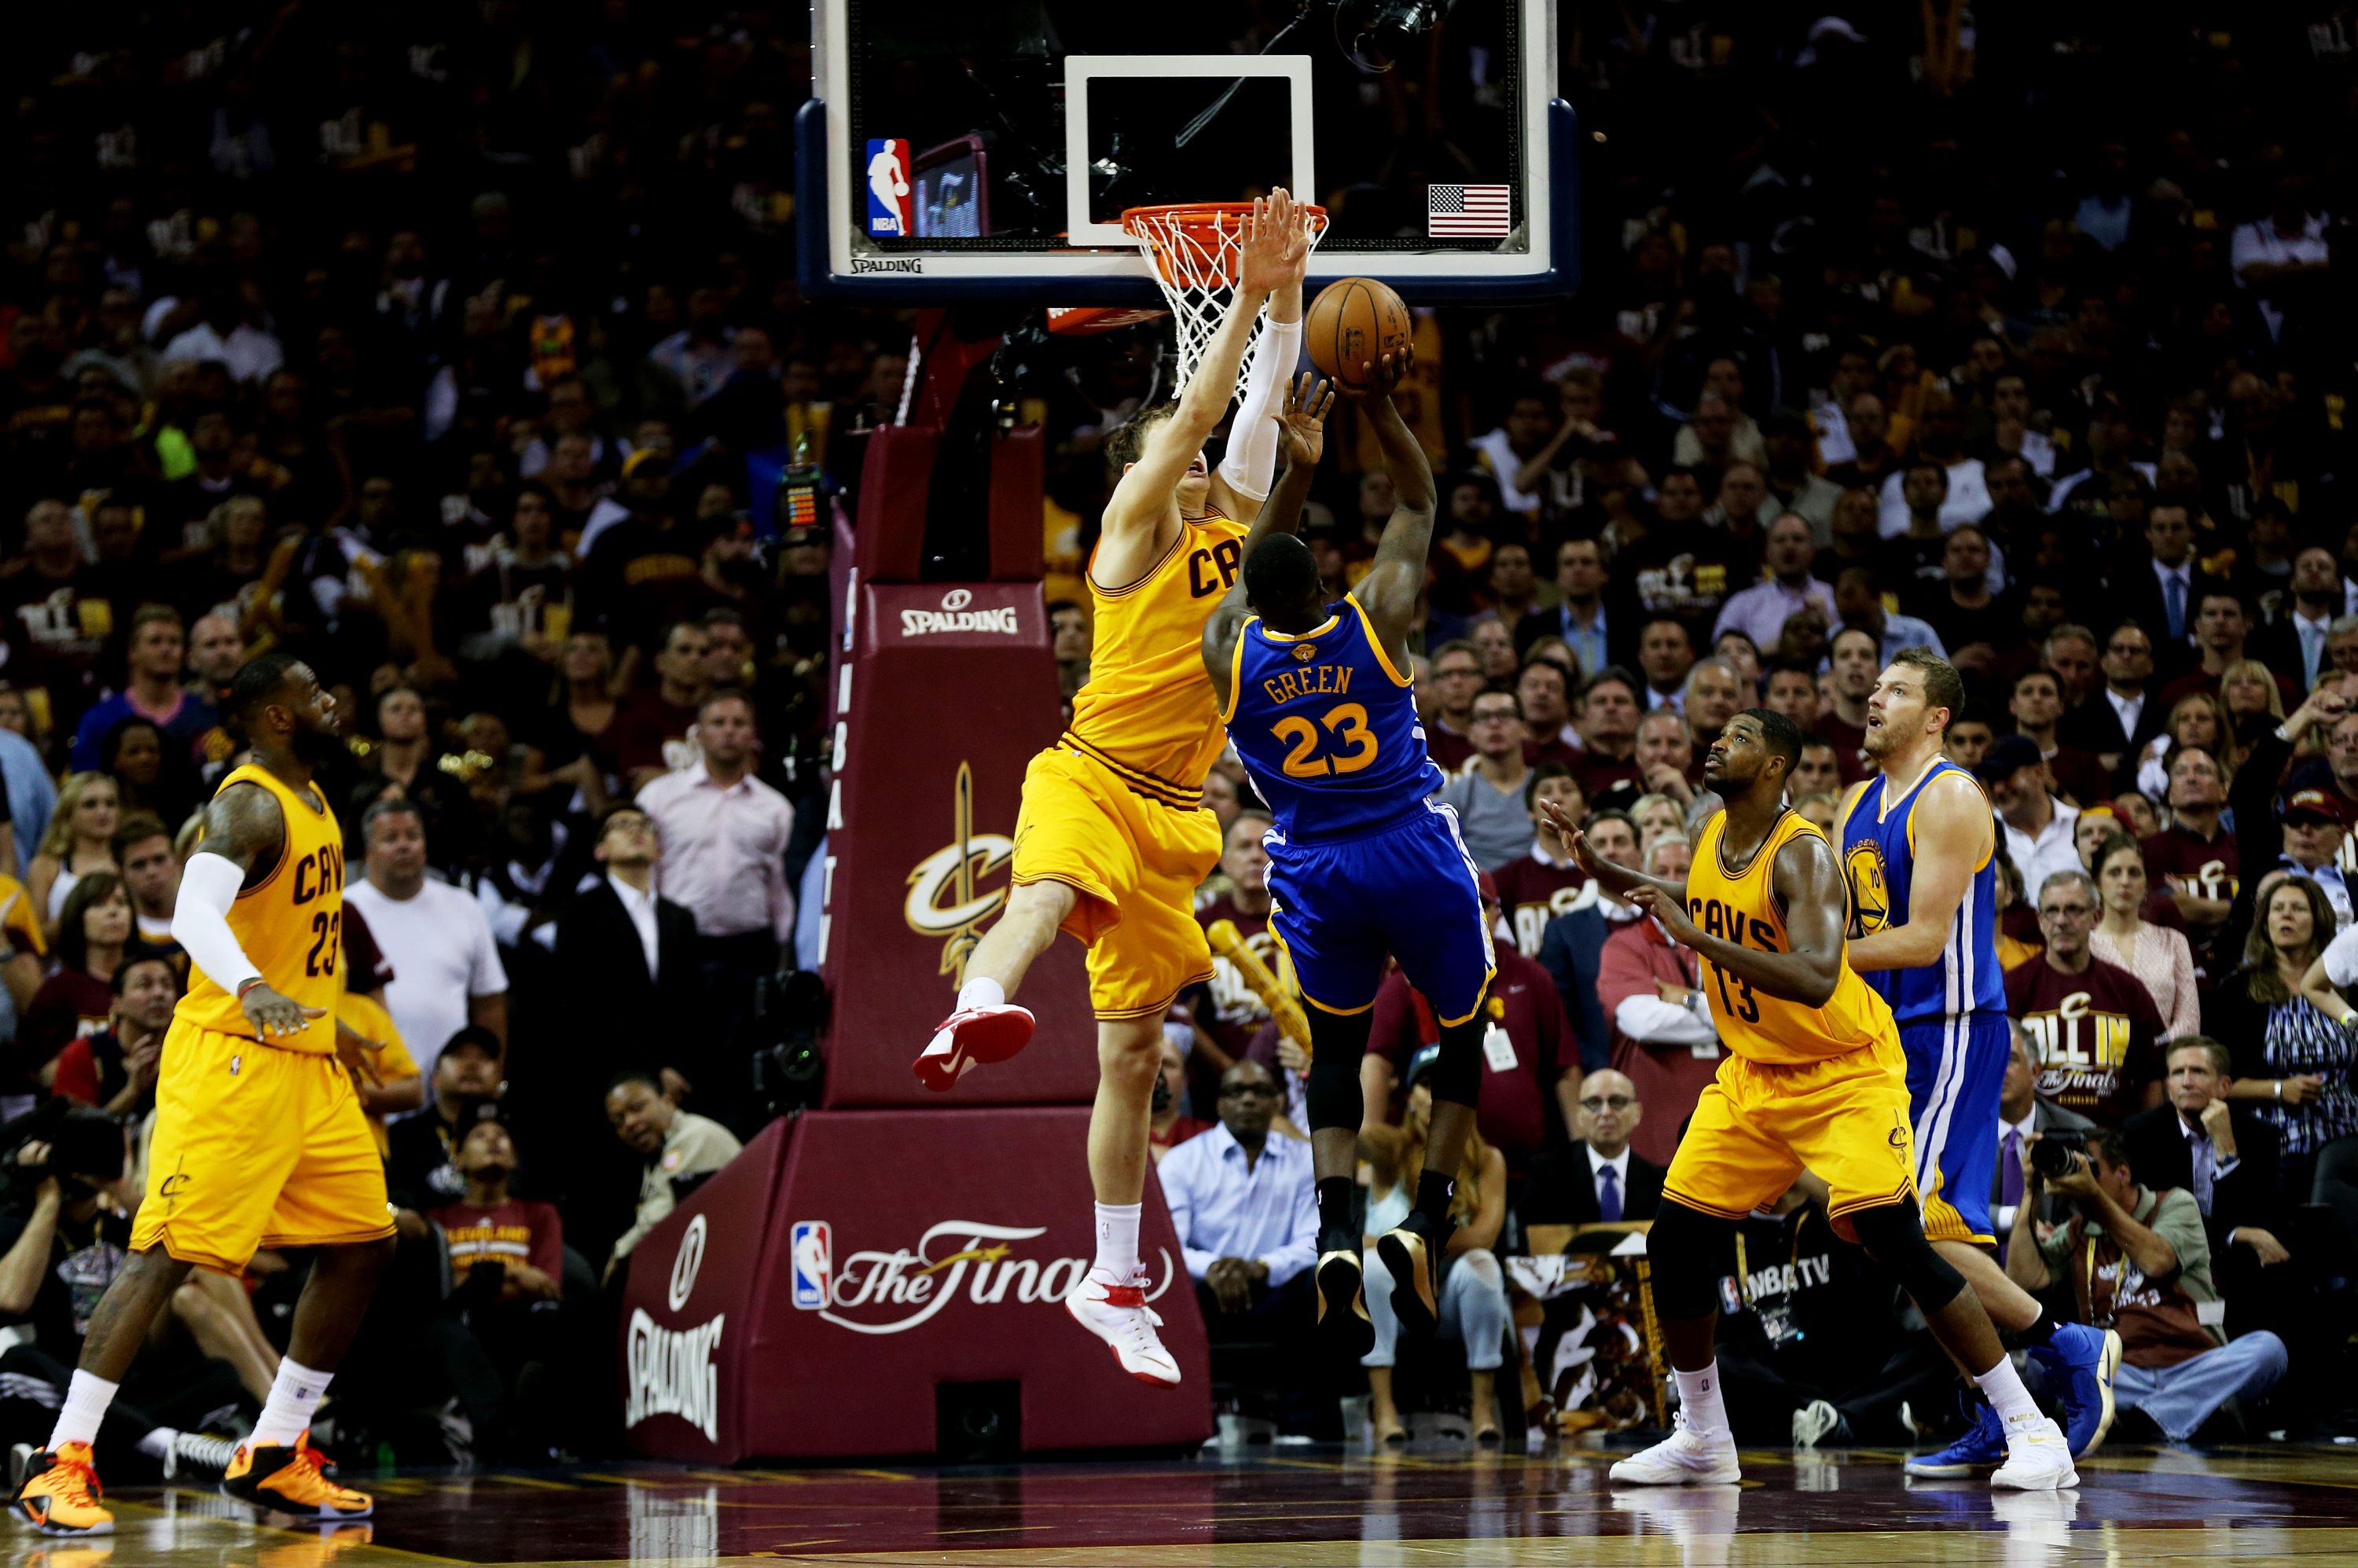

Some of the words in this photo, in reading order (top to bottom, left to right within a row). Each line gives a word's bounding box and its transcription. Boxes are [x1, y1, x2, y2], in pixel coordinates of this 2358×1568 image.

[872, 217, 898, 231] NBA
[851, 258, 924, 274] SPALDING
[902, 607, 1019, 637] SPALDING
[1264, 666, 1353, 705] GREEN
[1269, 702, 1379, 778] 23
[292, 843, 341, 906] CAV
[1871, 868, 1880, 889] 10
[305, 911, 340, 978] 23
[1710, 959, 1761, 1023] 13
[2095, 1015, 2131, 1067] IN
[833, 1247, 933, 1307] The
[1746, 1263, 1800, 1303] NBA
[1798, 1253, 1830, 1287] TV
[626, 1307, 725, 1443] SPALDING
